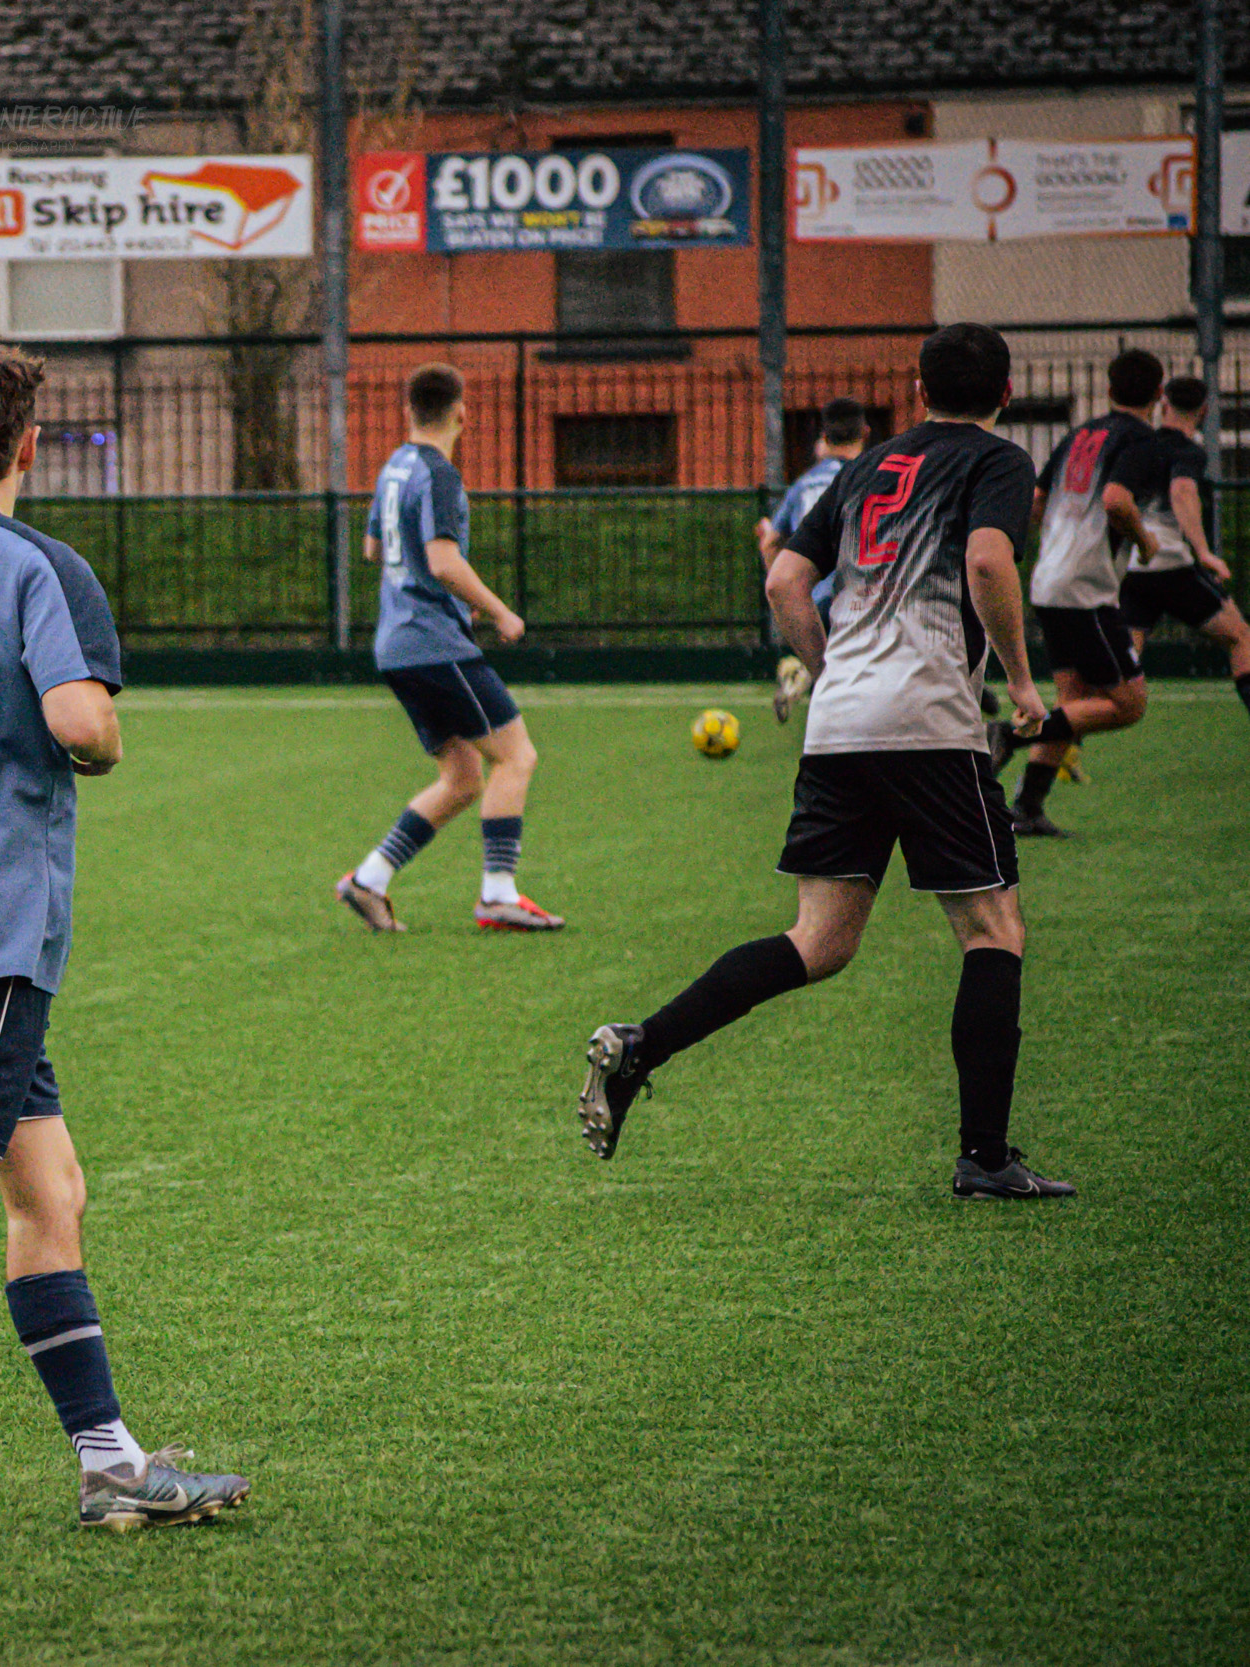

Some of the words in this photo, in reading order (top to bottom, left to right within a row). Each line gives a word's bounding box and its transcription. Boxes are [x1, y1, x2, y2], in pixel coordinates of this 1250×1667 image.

[432, 153, 621, 211] £1000
[32, 194, 126, 234] Skip
[139, 193, 227, 225] hire
[858, 454, 927, 566] 2
